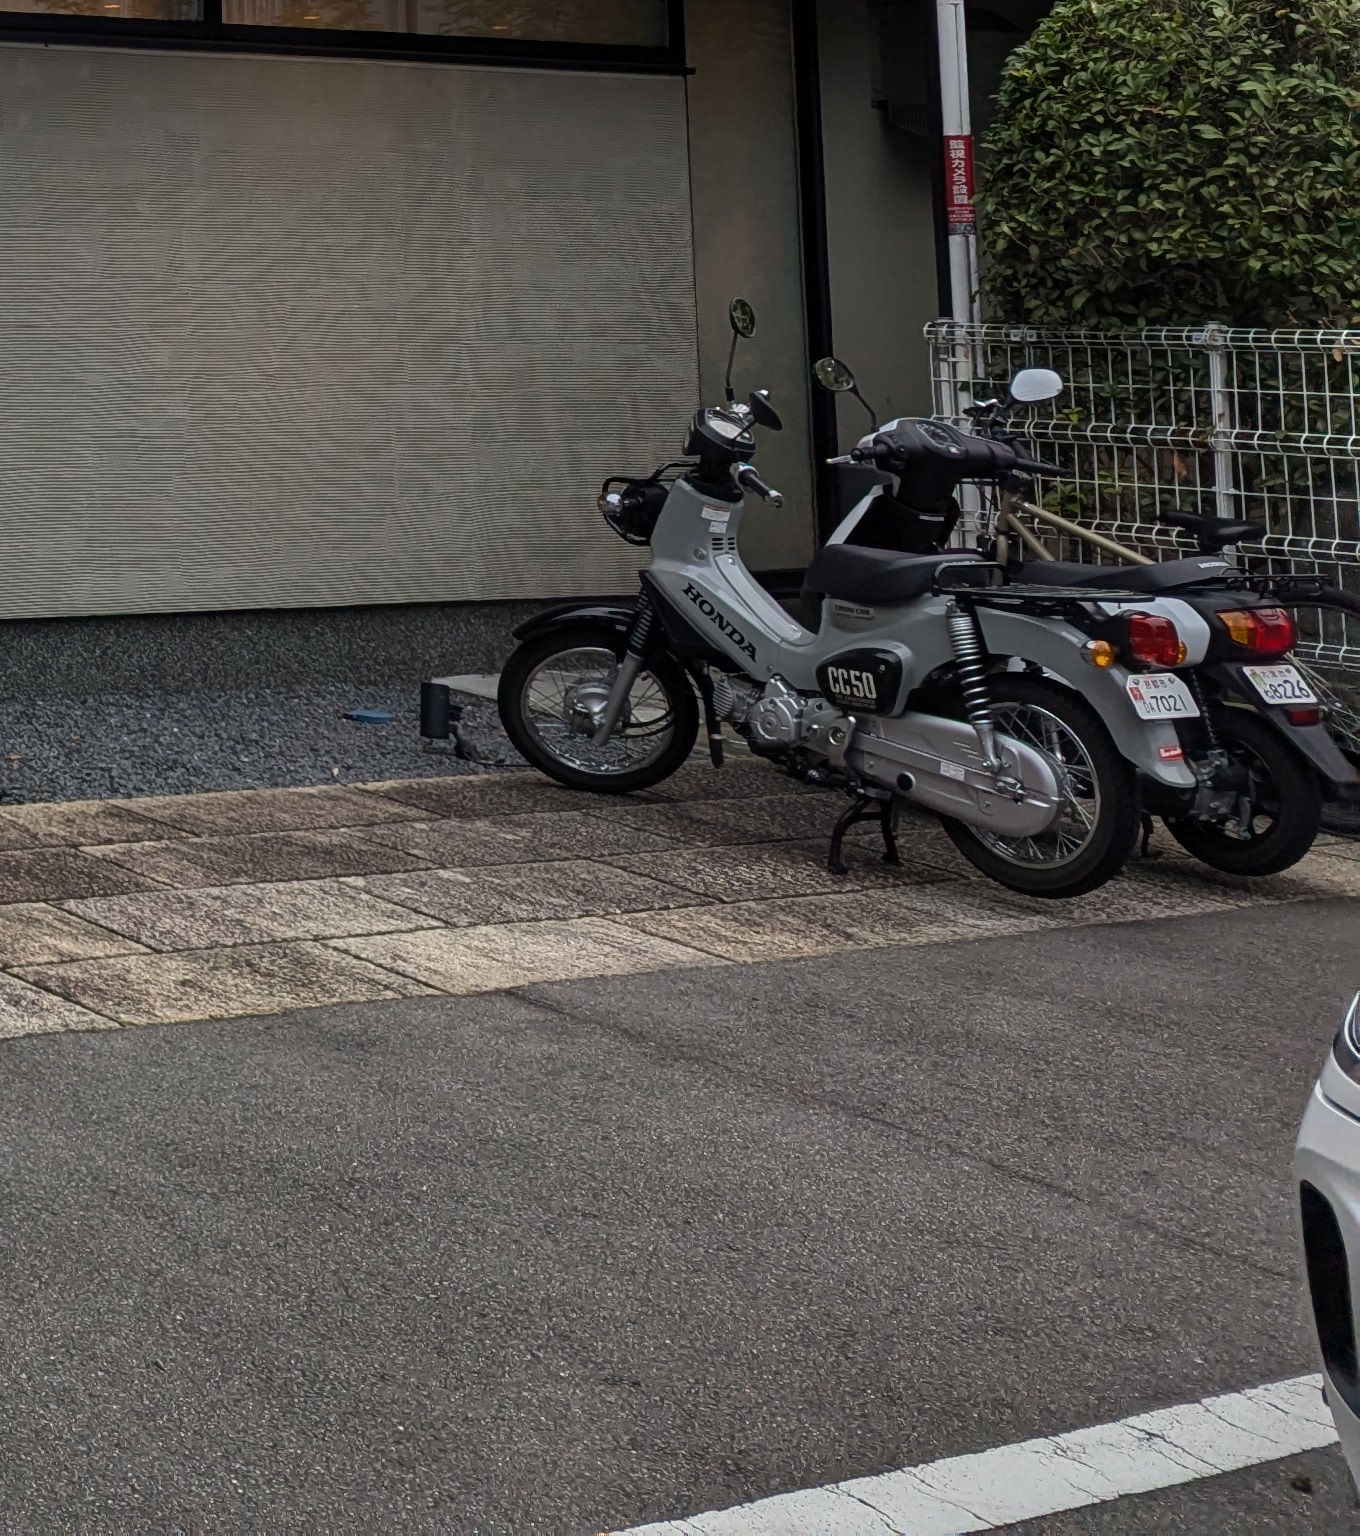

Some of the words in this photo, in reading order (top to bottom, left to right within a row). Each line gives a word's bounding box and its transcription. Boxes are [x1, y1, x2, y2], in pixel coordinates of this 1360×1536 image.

[681, 582, 756, 663] HONDA
[827, 666, 877, 699] CC50
[1269, 679, 1311, 699] 8226
[1150, 693, 1188, 713] 7021
